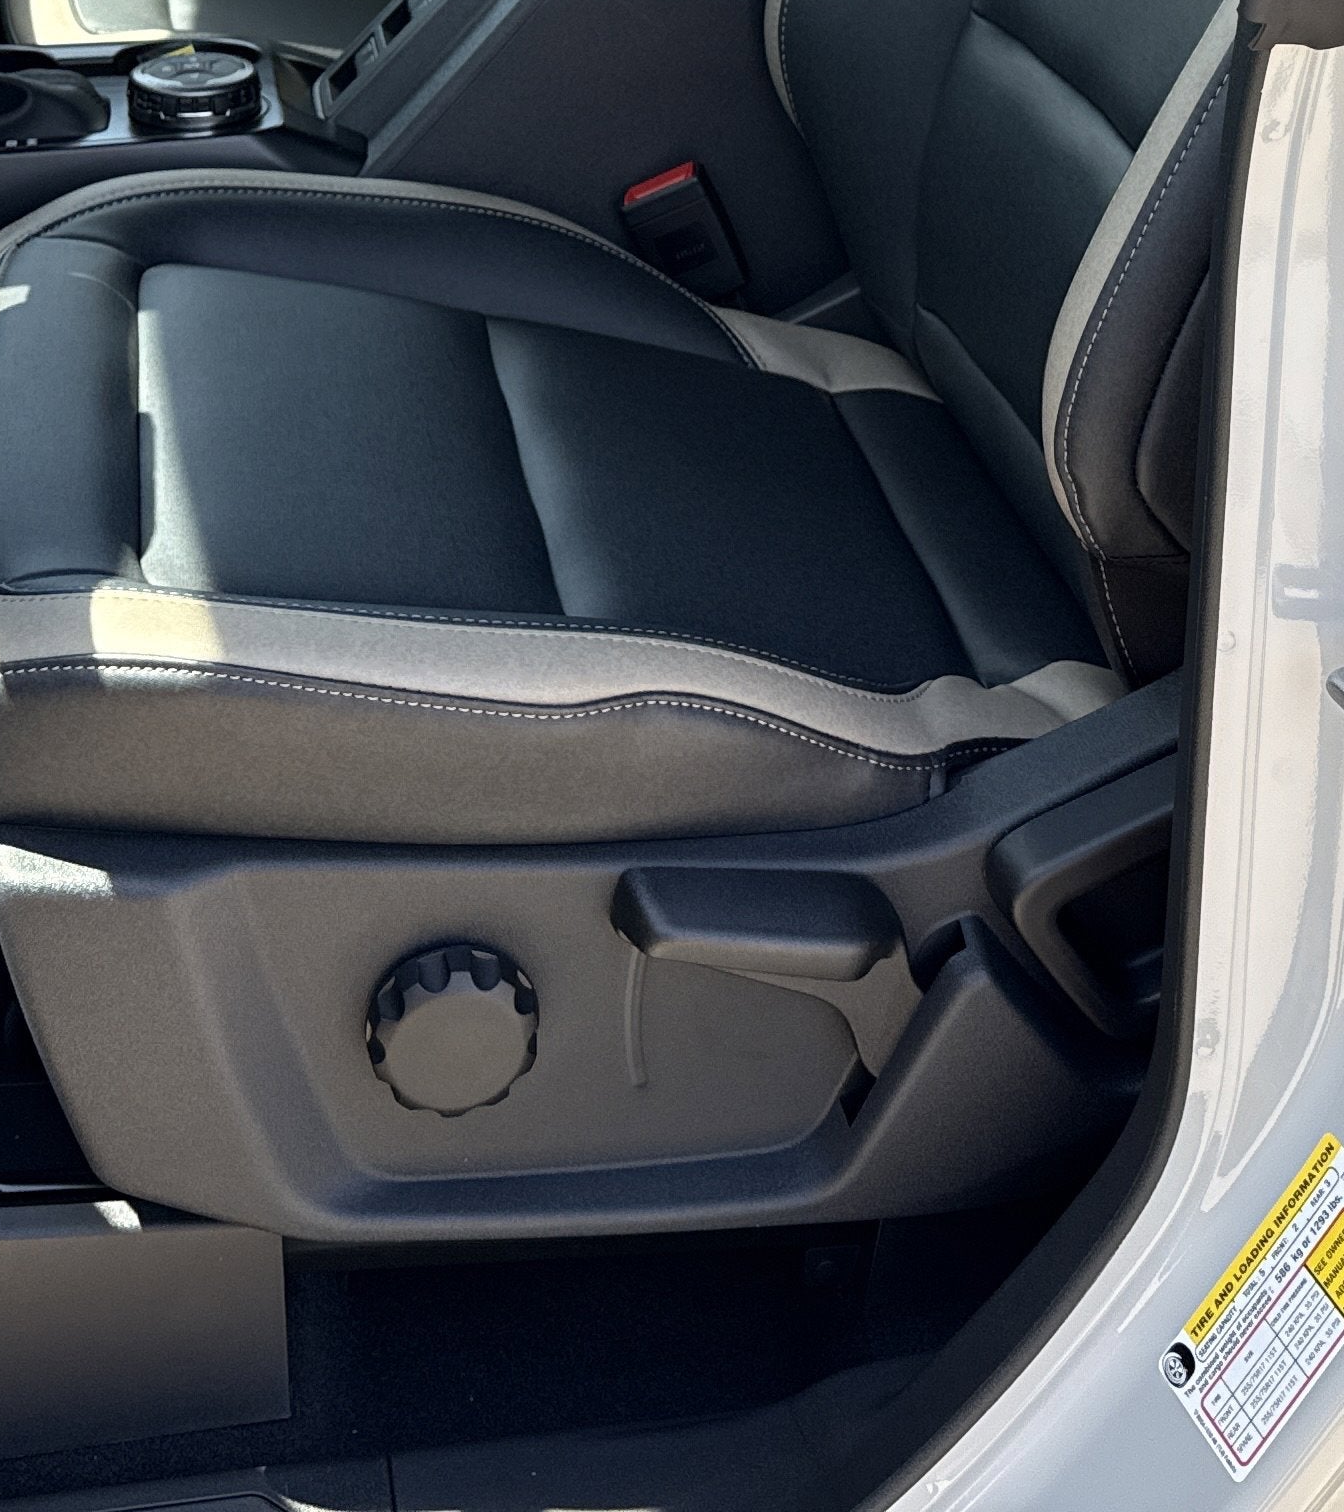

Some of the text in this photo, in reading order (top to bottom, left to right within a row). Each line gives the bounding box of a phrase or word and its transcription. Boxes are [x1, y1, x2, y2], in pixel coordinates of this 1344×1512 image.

[1190, 1141, 1335, 1339] TIRE AND LOADING INFORMATION
[1258, 1267, 1265, 1277] 5
[1291, 1222, 1299, 1232] 2
[1323, 1178, 1331, 1187] 3
[1274, 1191, 1342, 1284] 586 kg or 1293 lbs.
[1312, 1257, 1326, 1275] SEE
[1184, 1382, 1195, 1398] The
[1193, 1351, 1219, 1386] combined
[1218, 1329, 1237, 1355] weight
[1234, 1320, 1242, 1331] of
[1240, 1287, 1267, 1324] occupants
[1198, 1294, 1272, 1393] and cargo should never exceed
